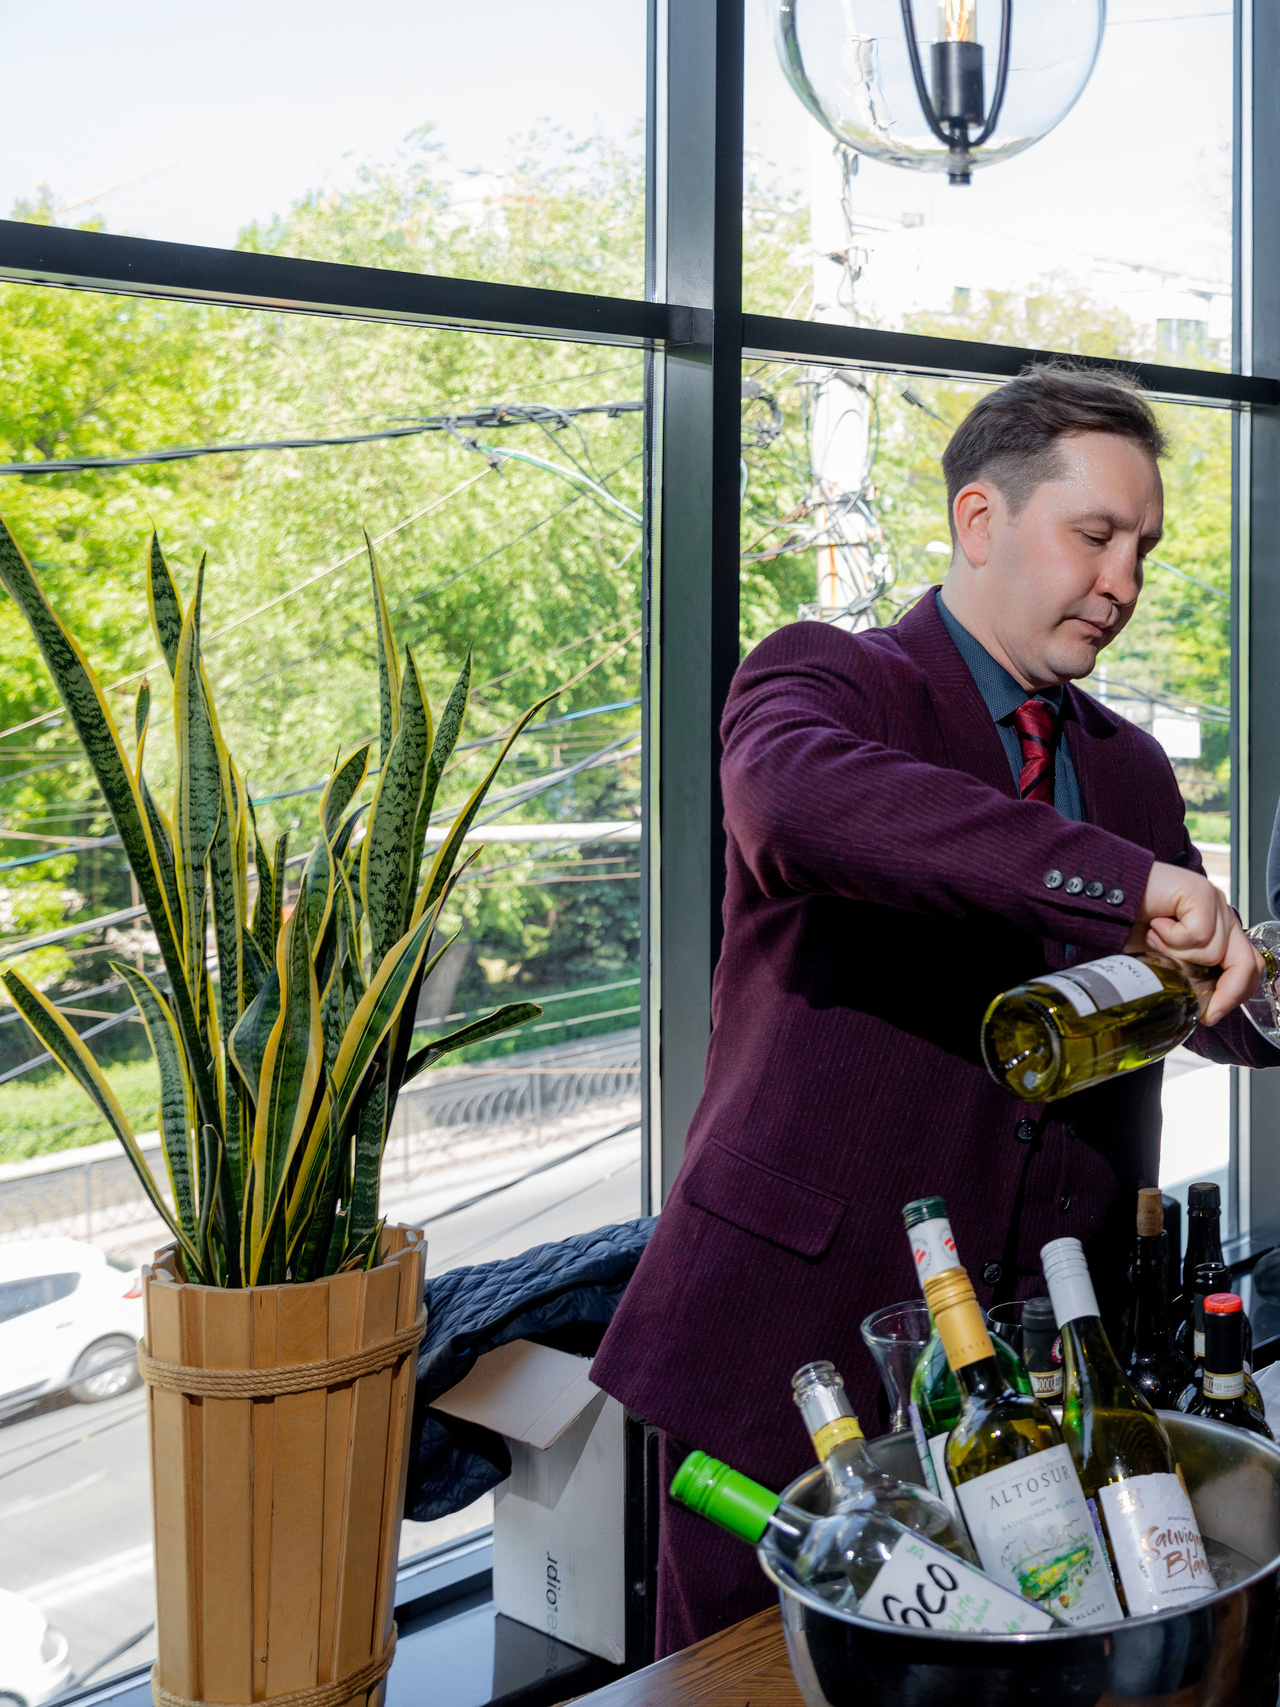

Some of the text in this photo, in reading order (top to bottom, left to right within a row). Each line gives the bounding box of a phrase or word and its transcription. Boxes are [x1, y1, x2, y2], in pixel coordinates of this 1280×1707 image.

[989, 1465, 1072, 1510] ALTOSUR
[1001, 1496, 1078, 1532] SAUVIGNON BLANC
